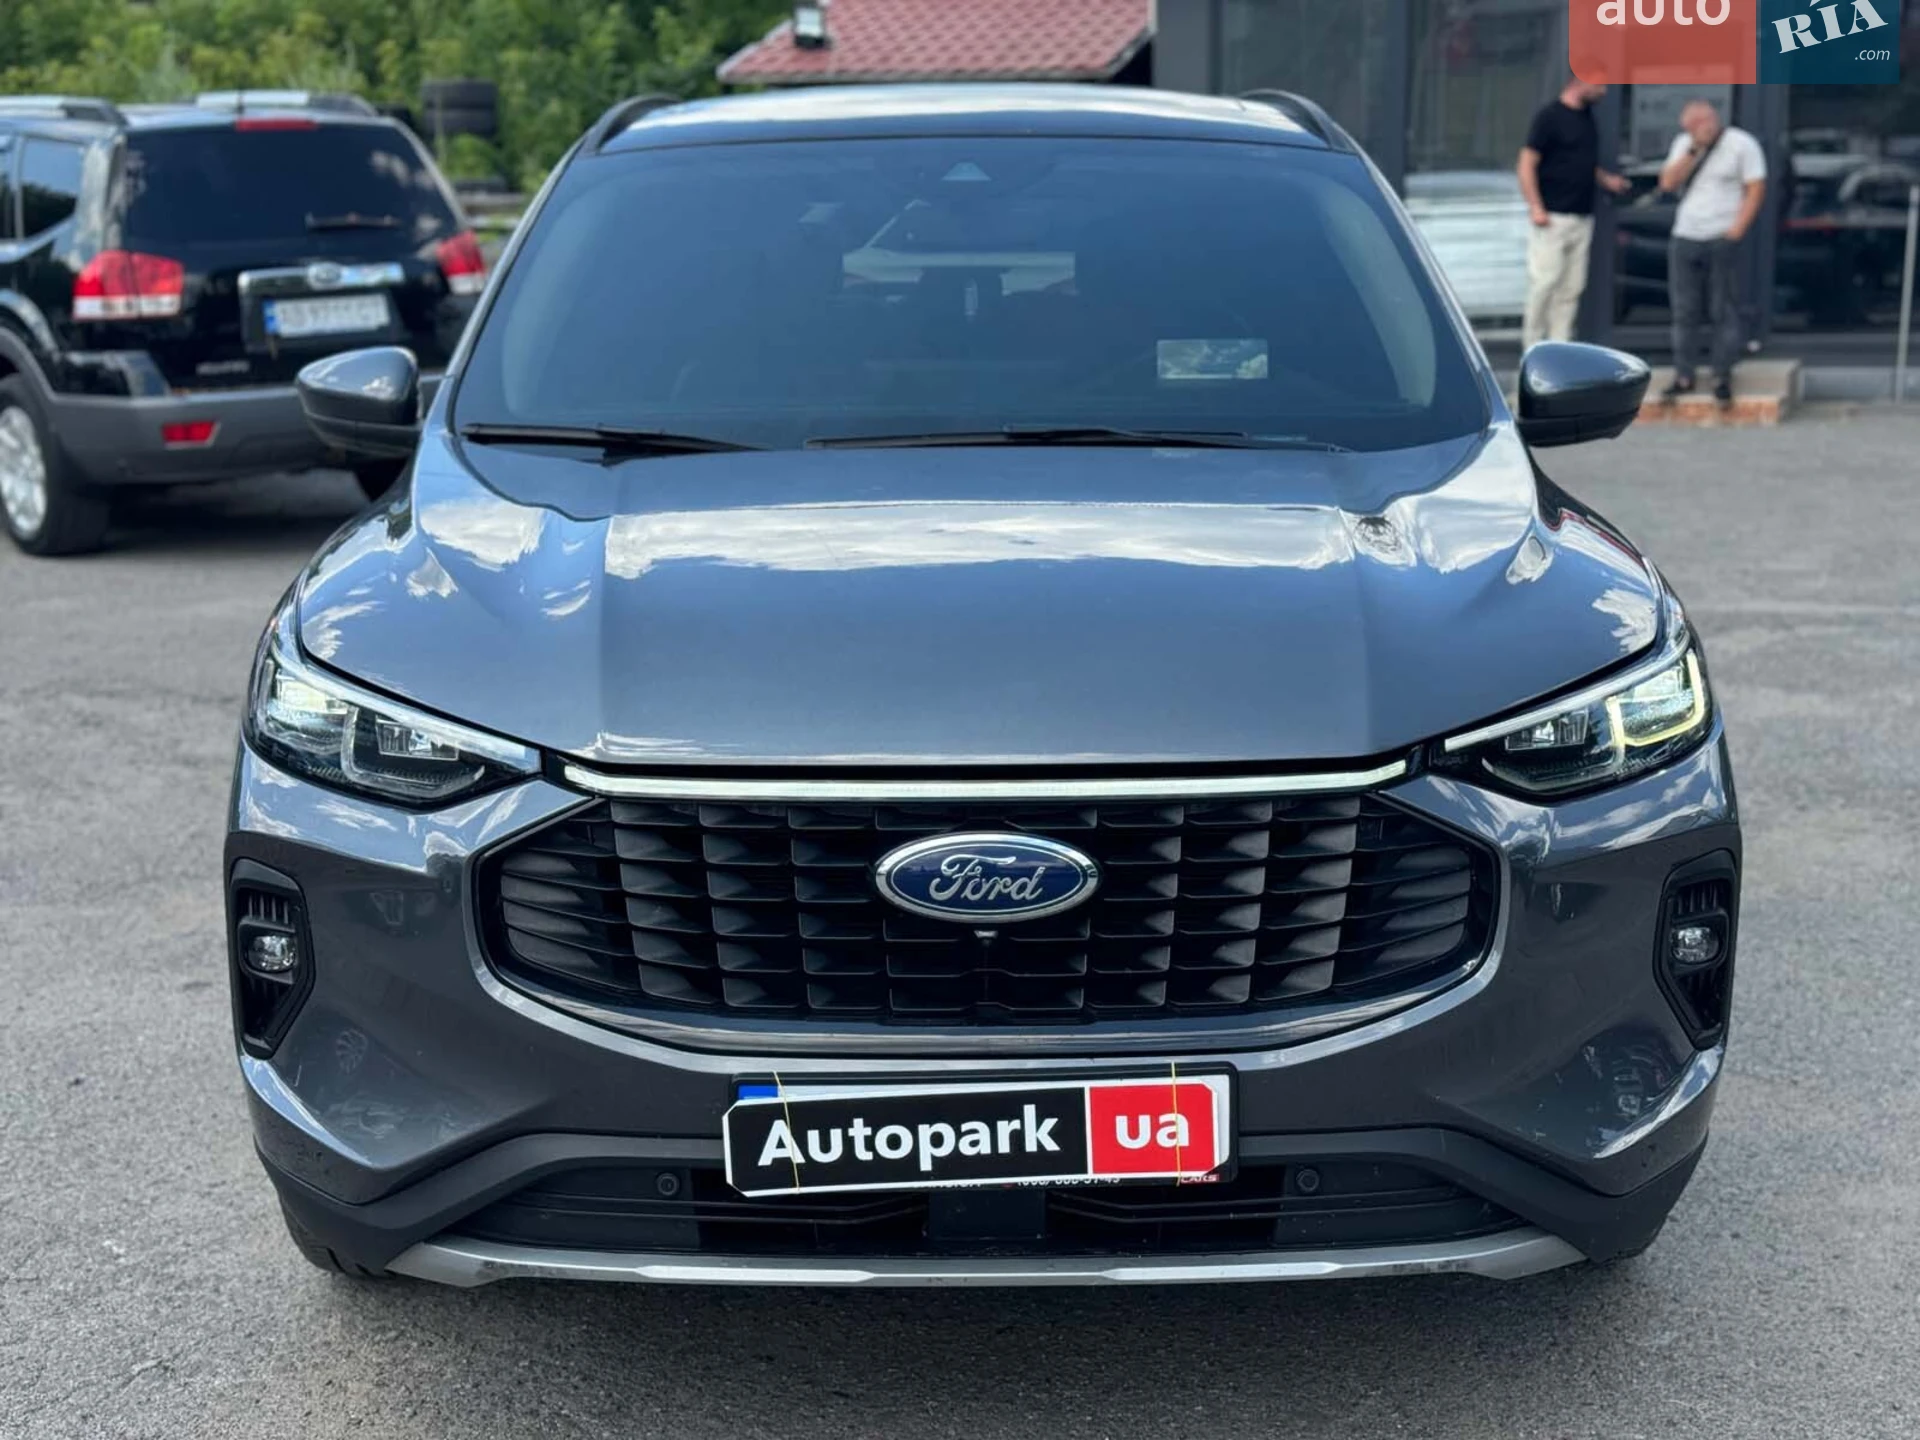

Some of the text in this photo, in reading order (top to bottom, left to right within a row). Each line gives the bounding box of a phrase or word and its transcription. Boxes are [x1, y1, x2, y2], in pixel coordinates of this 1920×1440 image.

[929, 854, 1046, 900] Ford
[757, 1104, 1189, 1171] Autopark ua
